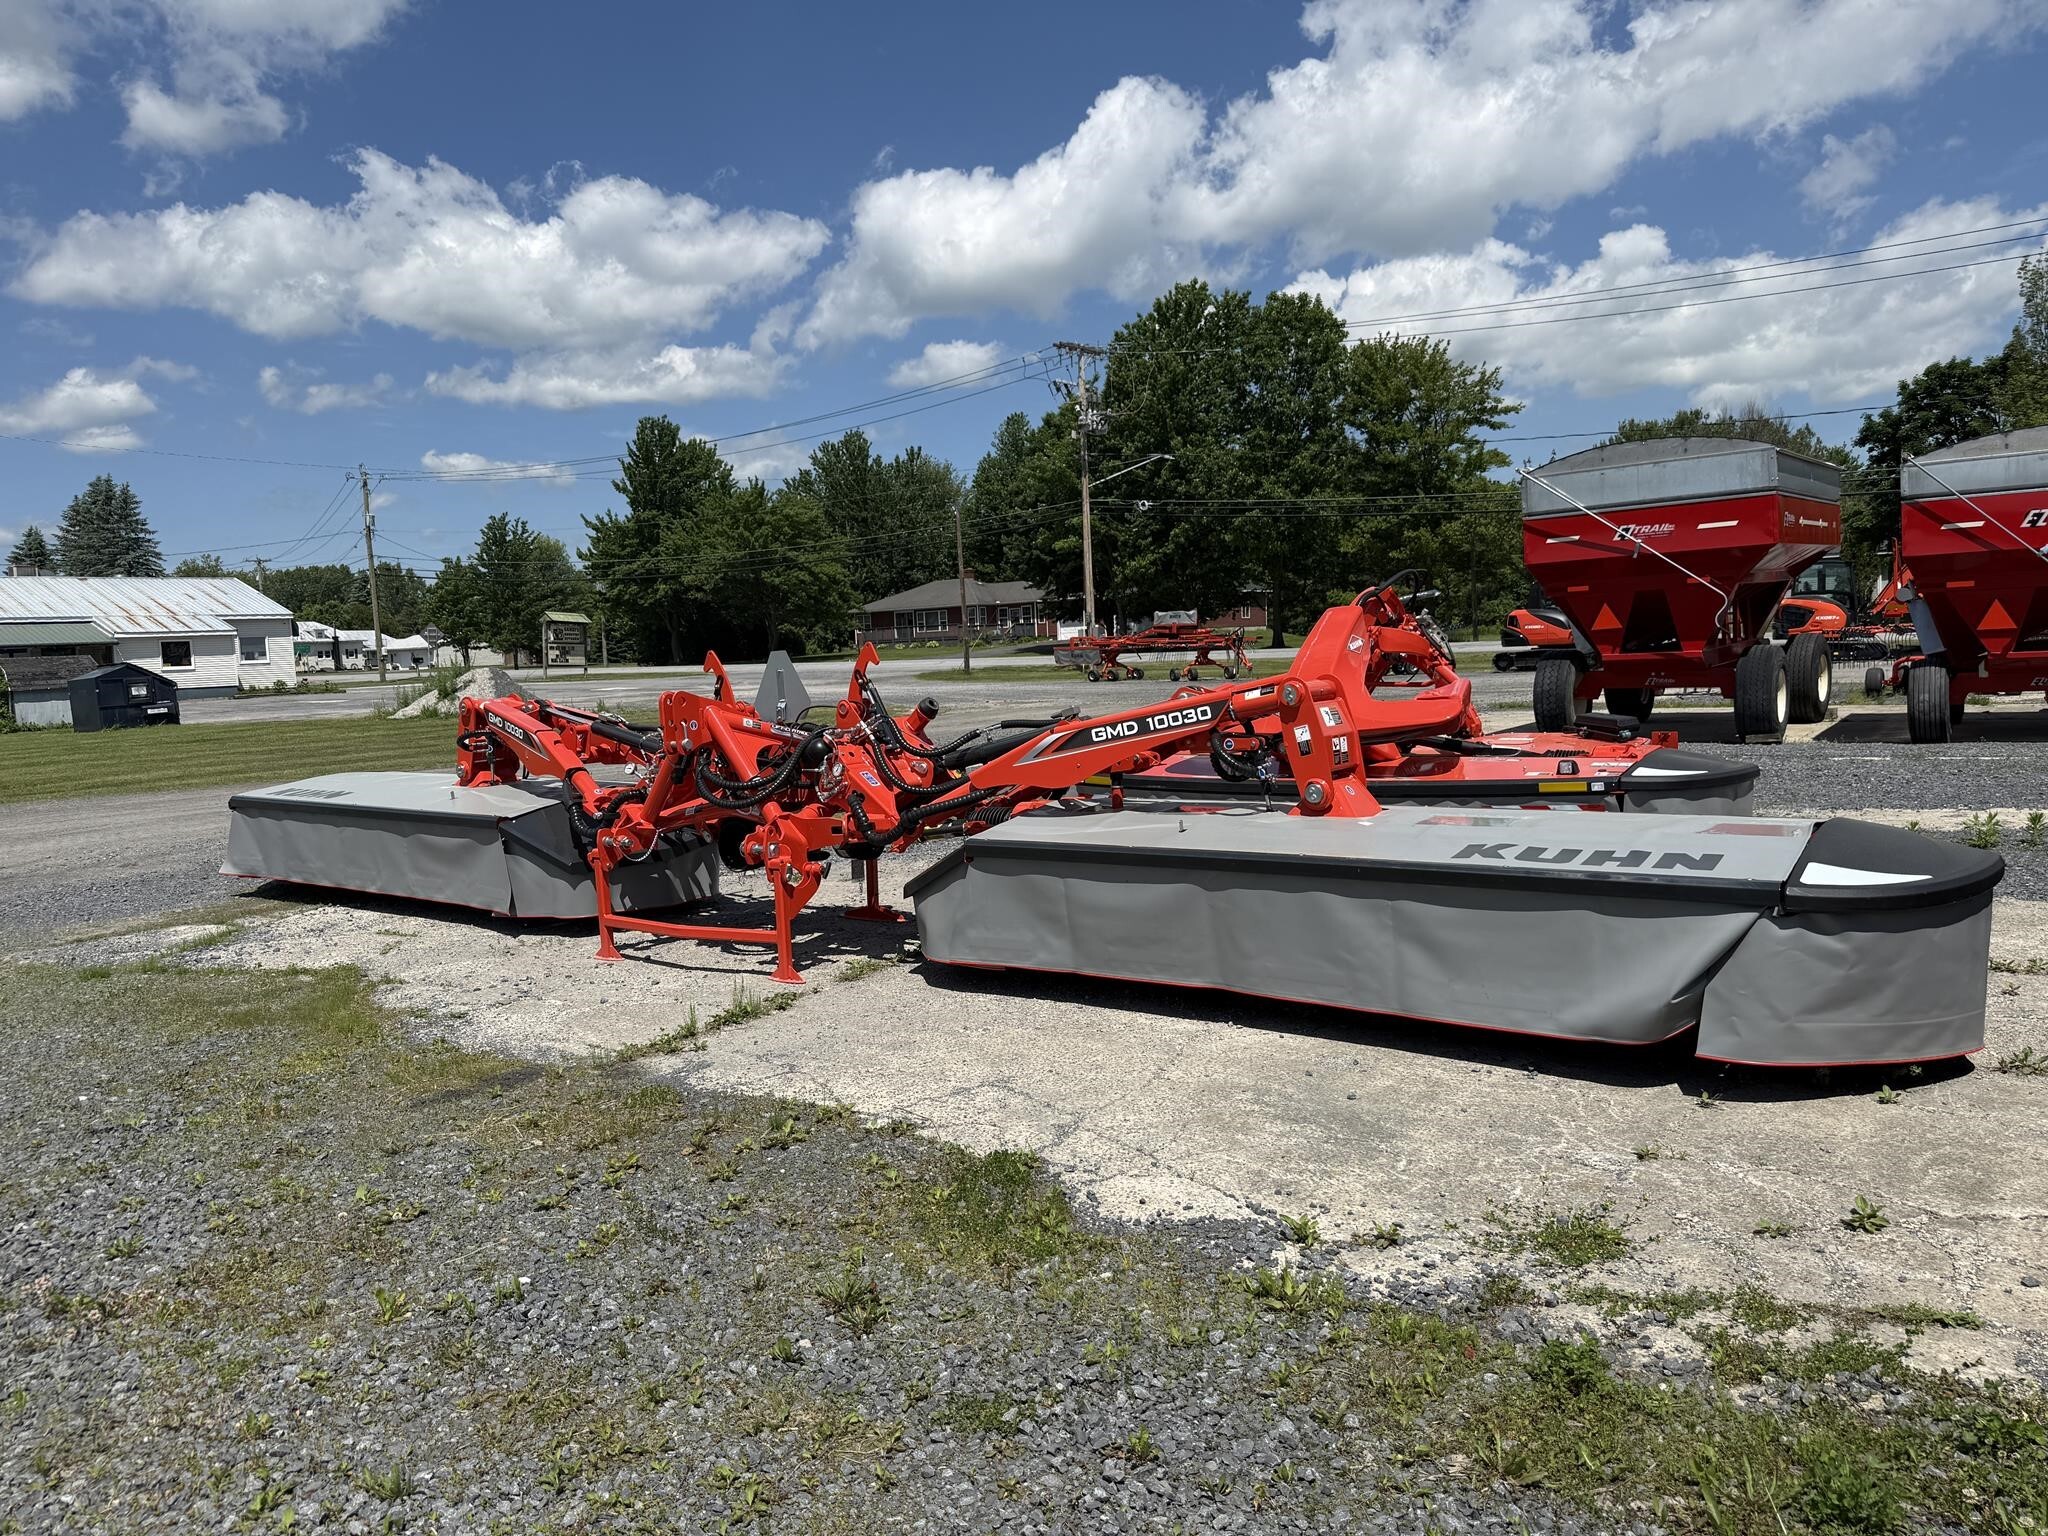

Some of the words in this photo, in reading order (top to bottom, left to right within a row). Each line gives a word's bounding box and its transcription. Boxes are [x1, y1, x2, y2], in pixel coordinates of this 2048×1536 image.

[488, 712, 503, 728] GMD
[504, 720, 524, 740] 10030
[1091, 721, 1139, 742] GMD
[1146, 706, 1212, 731] 10030
[1450, 843, 1725, 871] KUHN
